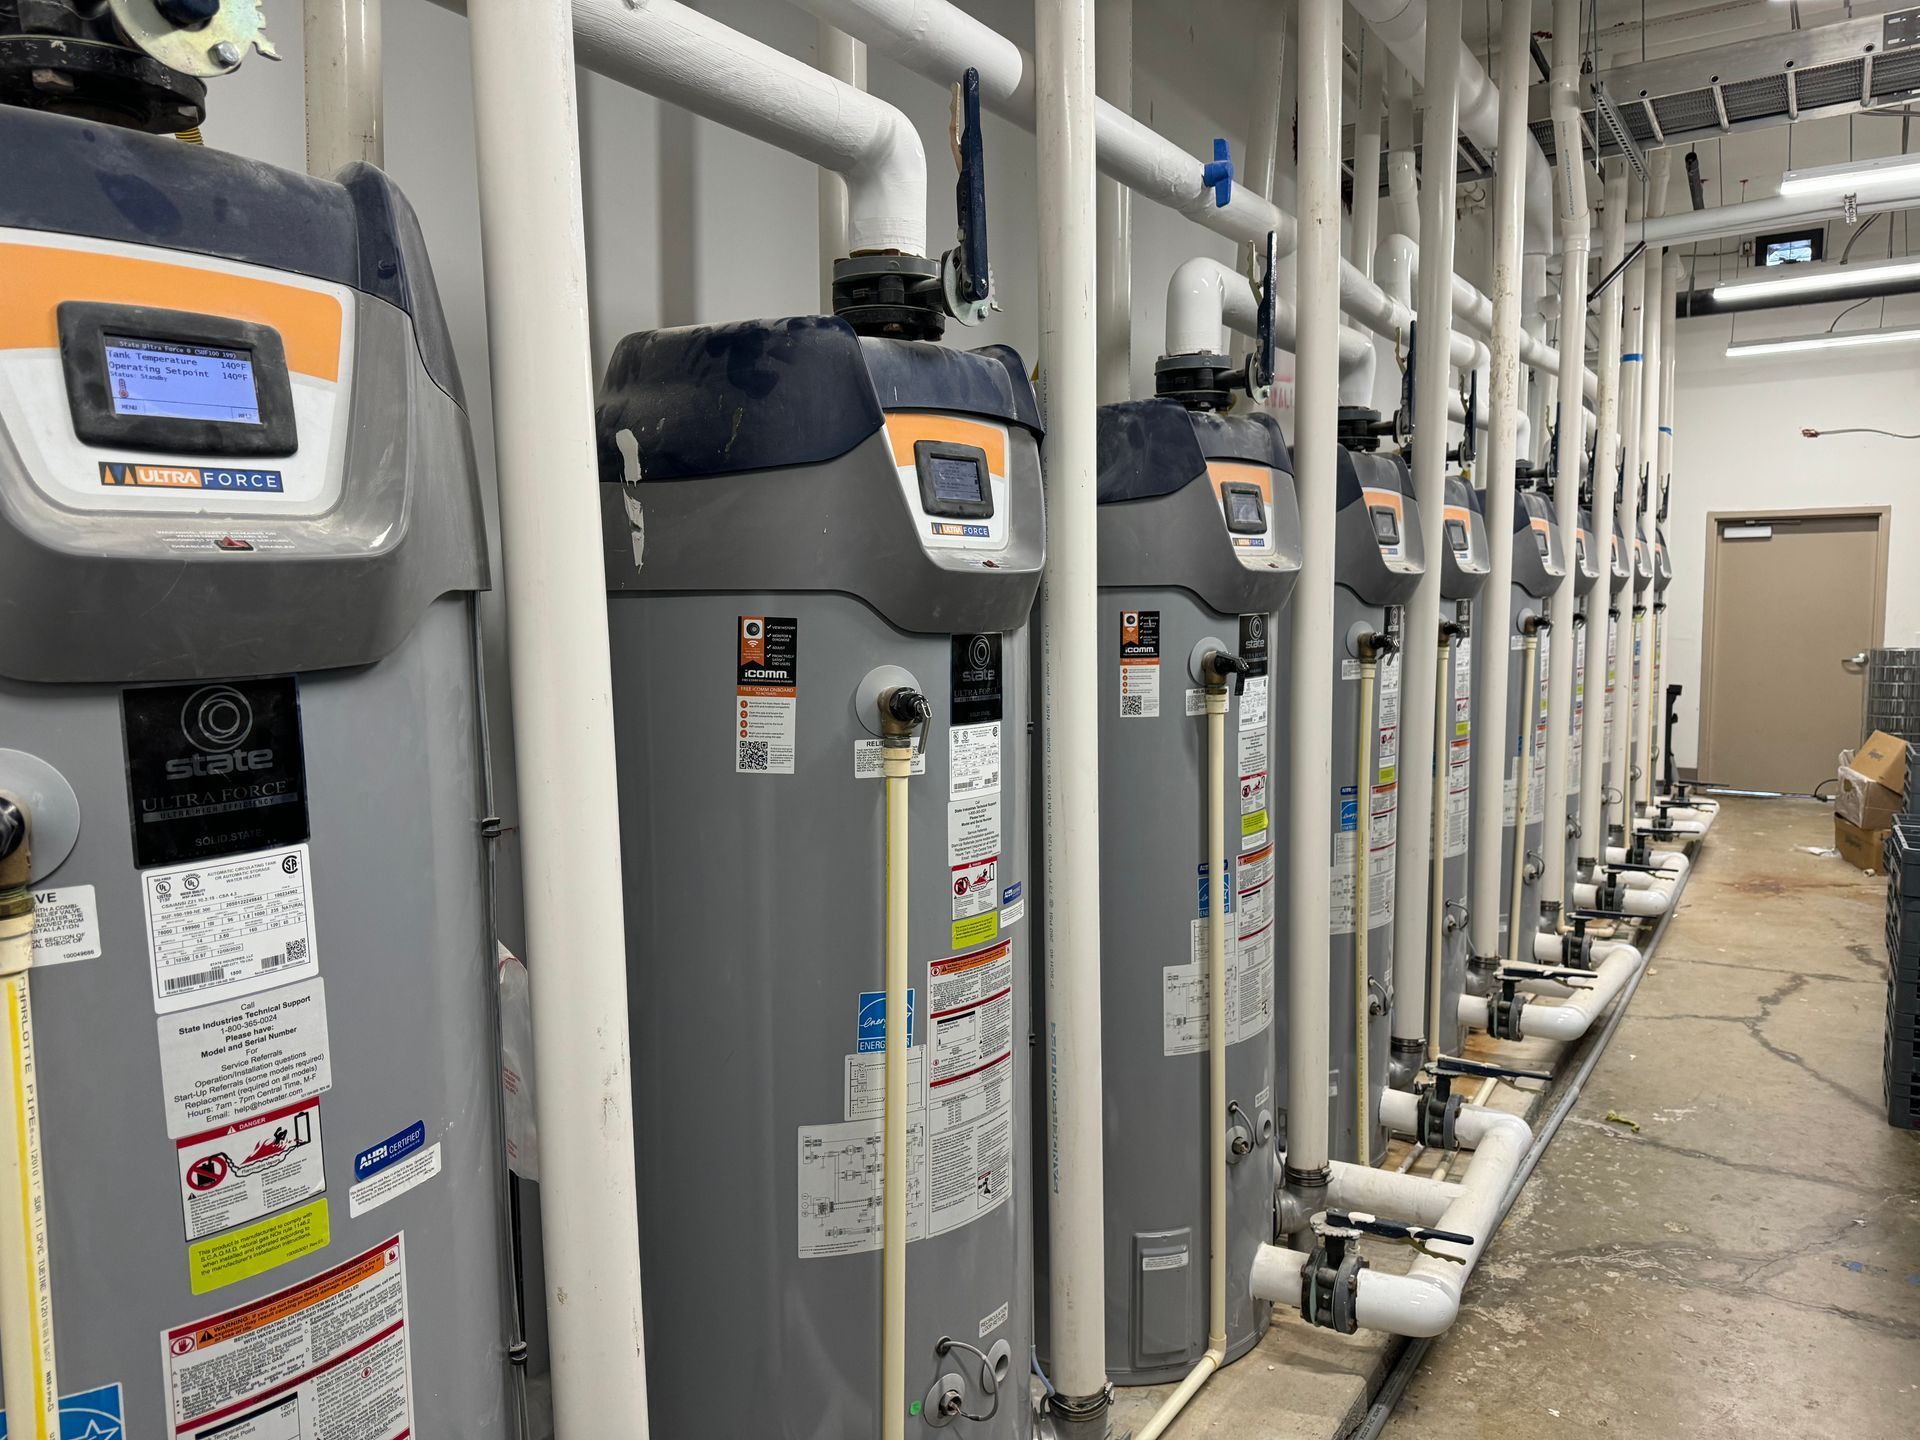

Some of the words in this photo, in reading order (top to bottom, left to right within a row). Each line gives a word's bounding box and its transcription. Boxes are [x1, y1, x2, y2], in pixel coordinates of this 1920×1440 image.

[107, 350, 130, 359] Tank
[135, 353, 198, 367] Temperature
[108, 361, 160, 374] Operating
[165, 366, 209, 378] Setpoint
[139, 468, 198, 484] ULTRA
[204, 472, 277, 488] FORCE
[964, 527, 987, 535] FORCE
[962, 669, 995, 682] state
[166, 748, 273, 780] state
[142, 792, 216, 812] ULTRA
[222, 780, 287, 800] FORCE
[46, 939, 70, 947] CHECK
[178, 1023, 200, 1036] State
[202, 1012, 243, 1030] Industries
[244, 1003, 280, 1019] Technical
[282, 994, 310, 1010] Support
[240, 1001, 255, 1011] Call
[220, 1013, 277, 1035] 1-800-365-0024
[225, 1029, 251, 1043] Please
[253, 1024, 274, 1035] have:
[18, 976, 32, 1074] CHARLOTTE
[26, 1084, 36, 1127] PIPE
[200, 1045, 225, 1058] Model
[227, 1041, 242, 1051] and
[244, 1034, 266, 1047] Serial
[268, 1026, 296, 1040] Number
[245, 1046, 258, 1056] For
[860, 1040, 886, 1050] ENERG
[194, 1059, 273, 1090] Operation/Installation
[274, 1049, 306, 1066] questions
[220, 1057, 249, 1072] Service
[250, 1048, 282, 1063] Referrals
[173, 1086, 207, 1104] Start-Up
[209, 1077, 243, 1095] Referrals
[245, 1070, 267, 1085] (some
[268, 1062, 294, 1076] models
[295, 1052, 324, 1069] required)
[184, 1088, 235, 1112] Replacement
[237, 1079, 269, 1096] (required
[271, 1077, 280, 1085] on
[281, 1072, 290, 1081] all
[291, 1064, 317, 1078] models)
[186, 1104, 213, 1119] Hours:
[215, 1099, 232, 1111] 7am
[239, 1092, 255, 1105] 7pm
[256, 1084, 282, 1099] Central
[283, 1078, 302, 1090] Time,
[303, 1072, 316, 1083] M-F
[206, 1109, 229, 1123] Email:
[234, 1087, 303, 1116] help@hotwater.com
[238, 1116, 266, 1130] DANGER
[388, 1130, 420, 1154] CERTIFIED
[241, 1162, 265, 1174] Flammable
[265, 1157, 280, 1167] Vapors
[198, 1247, 210, 1257] This
[211, 1240, 233, 1253] product
[240, 1225, 276, 1243] manufactured
[283, 1216, 300, 1227] comply
[302, 1211, 312, 1219] with
[239, 1238, 258, 1250] natural
[259, 1234, 268, 1243] gas
[282, 1224, 292, 1233] rule
[200, 1268, 210, 1276] the
[211, 1252, 252, 1274] manufacturer's
[253, 1242, 281, 1258] installation
[202, 1258, 218, 1269] when
[219, 1249, 242, 1264] installed
[244, 1246, 254, 1254] and
[255, 1237, 278, 1251] operated
[279, 1227, 303, 1242] according
[213, 1315, 248, 1333] WARNING:
